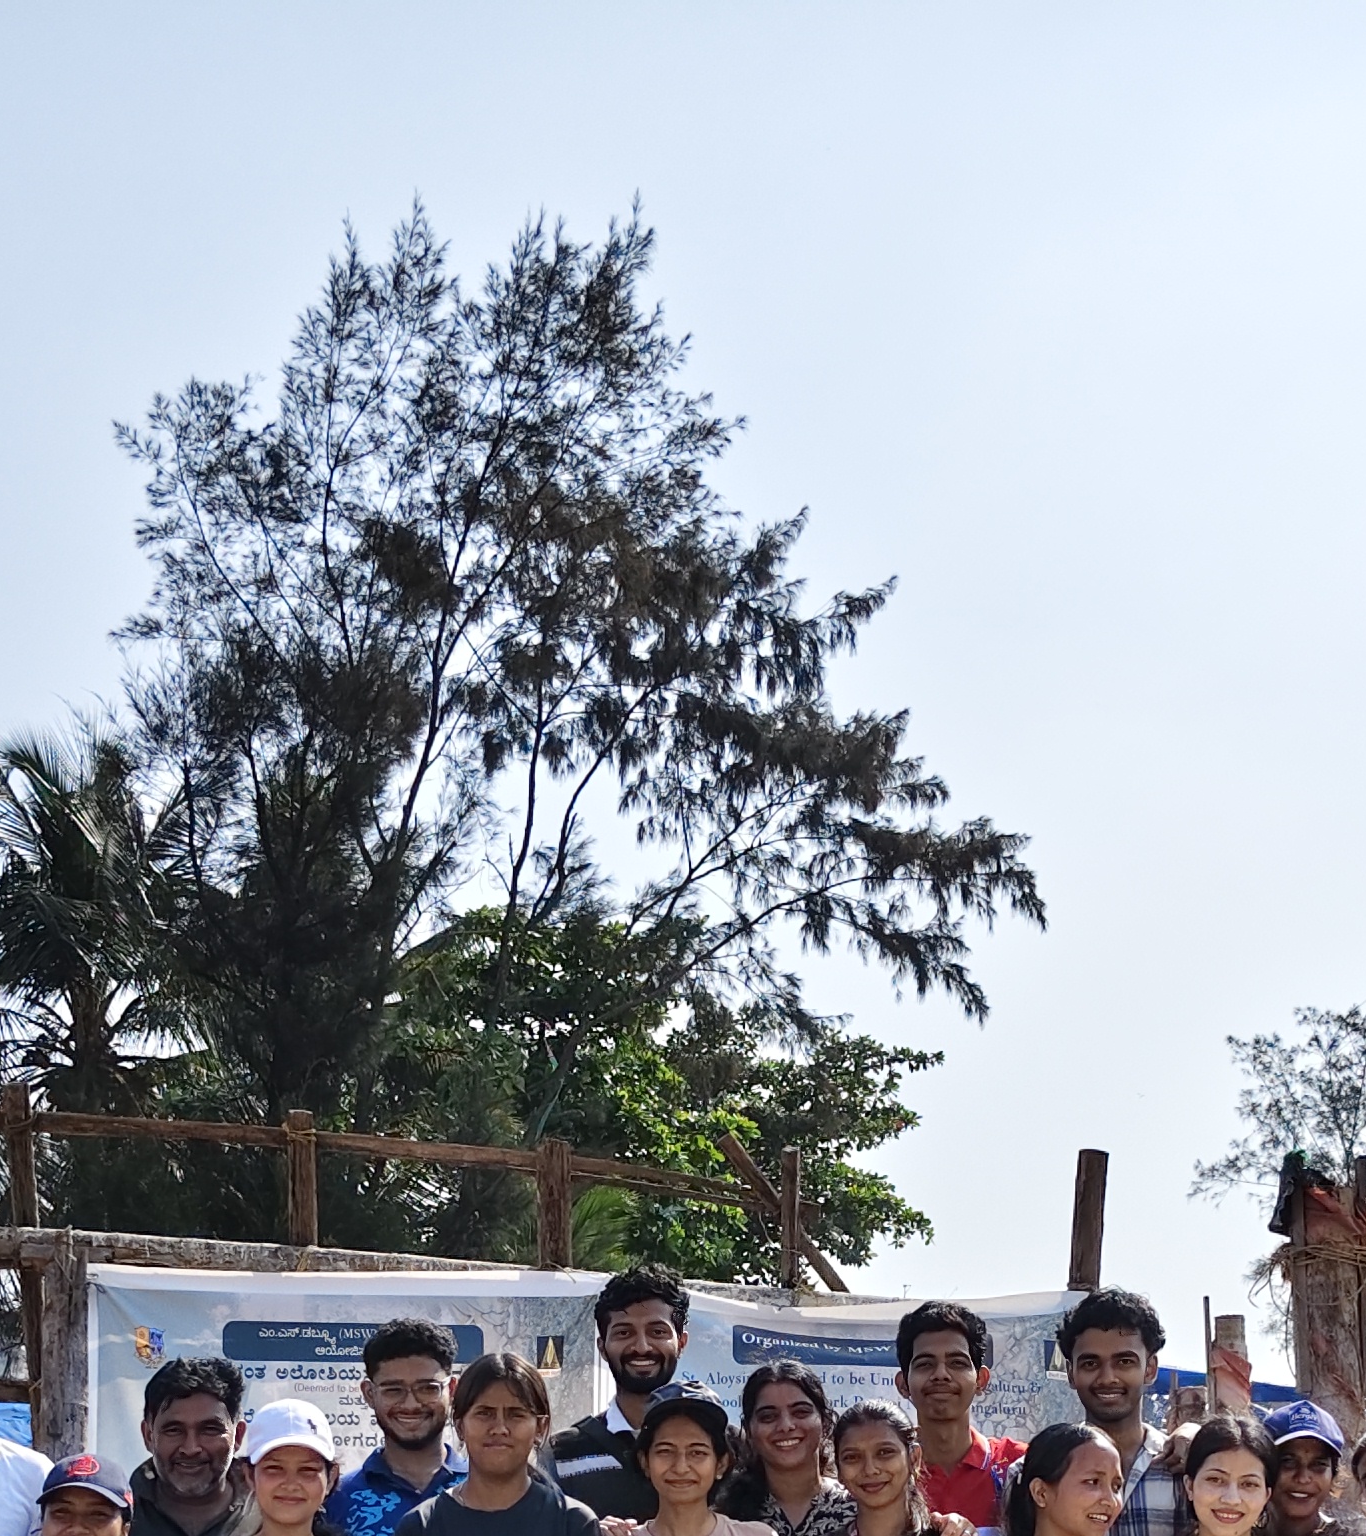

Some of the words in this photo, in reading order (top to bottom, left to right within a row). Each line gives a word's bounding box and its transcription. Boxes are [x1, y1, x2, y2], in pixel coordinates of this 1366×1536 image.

[741, 1332, 819, 1348] Organized
[823, 1343, 842, 1352] by
[832, 1375, 845, 1385] to
[849, 1372, 866, 1385] be
